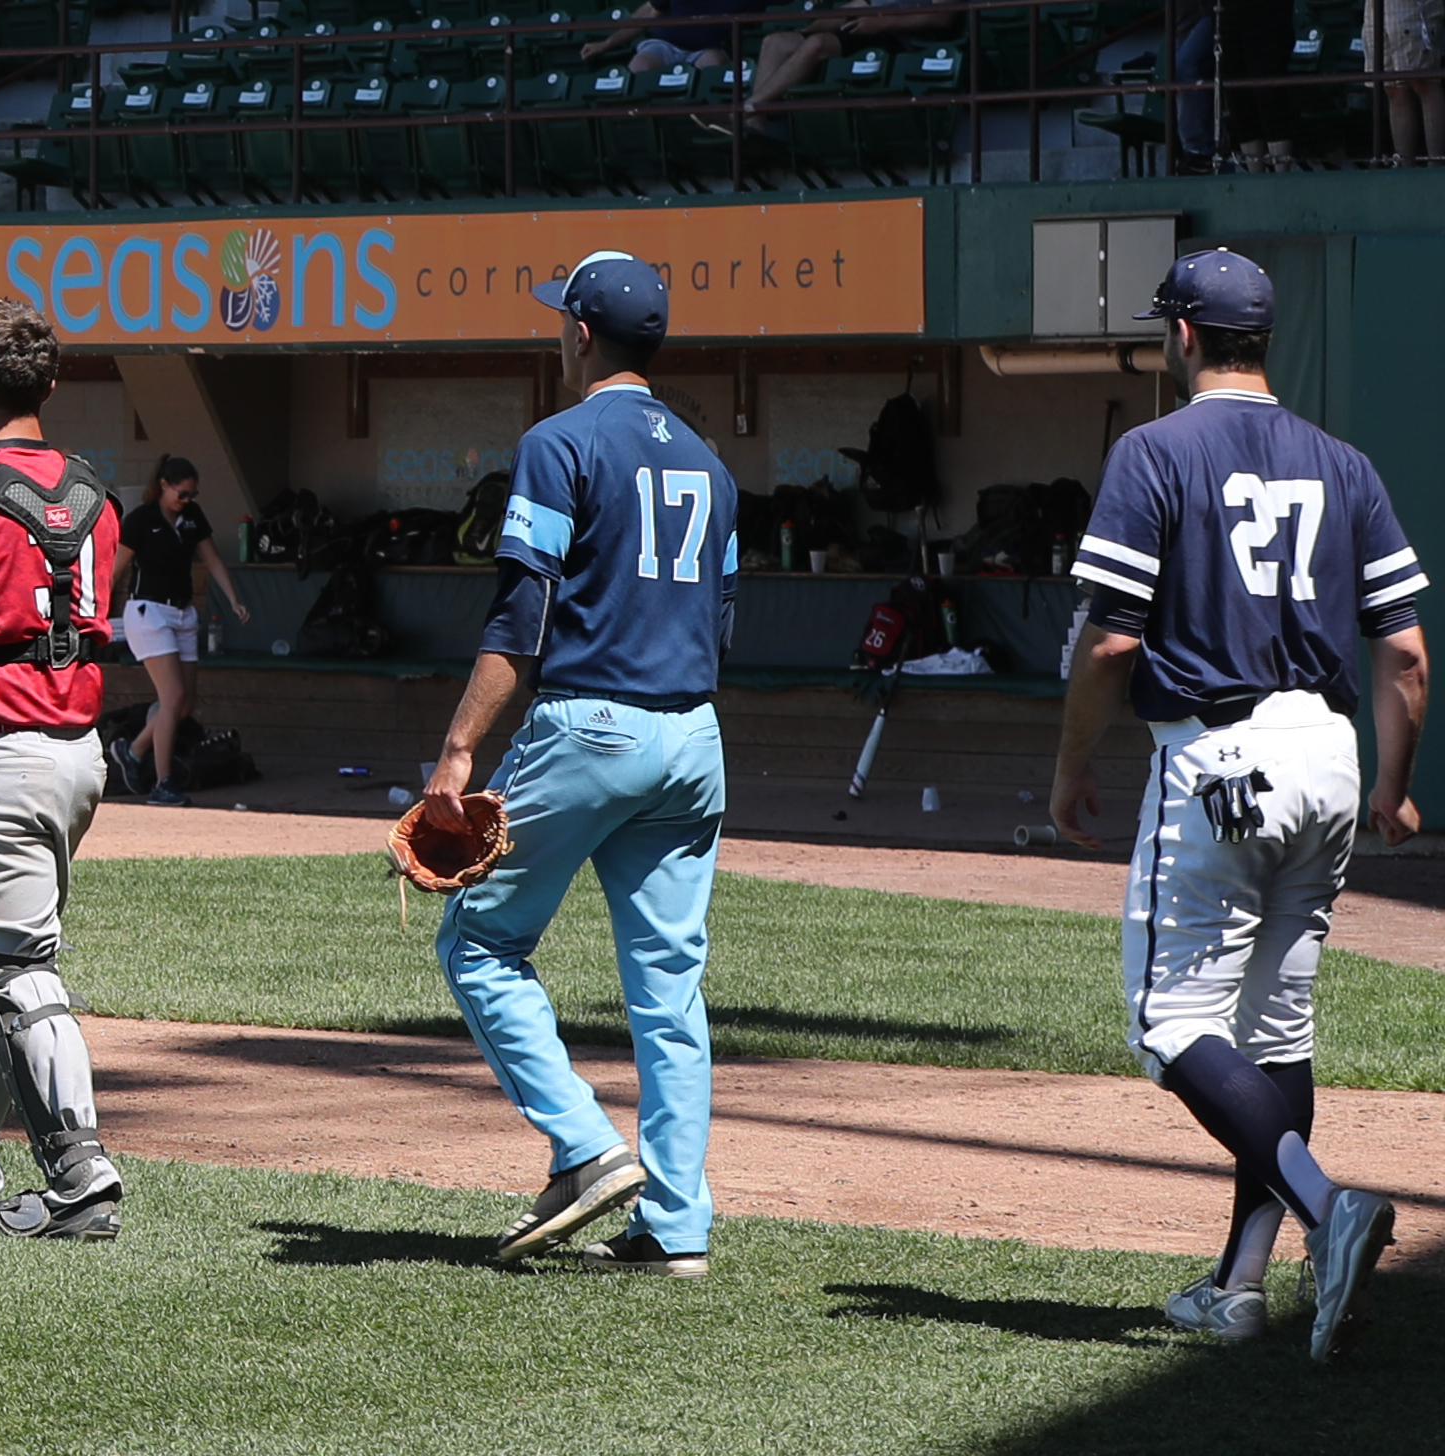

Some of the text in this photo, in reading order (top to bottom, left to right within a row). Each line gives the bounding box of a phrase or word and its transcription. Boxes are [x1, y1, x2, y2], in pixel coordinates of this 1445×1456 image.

[416, 264, 568, 297] corne
[635, 466, 711, 583] 17
[1223, 472, 1325, 602] 27
